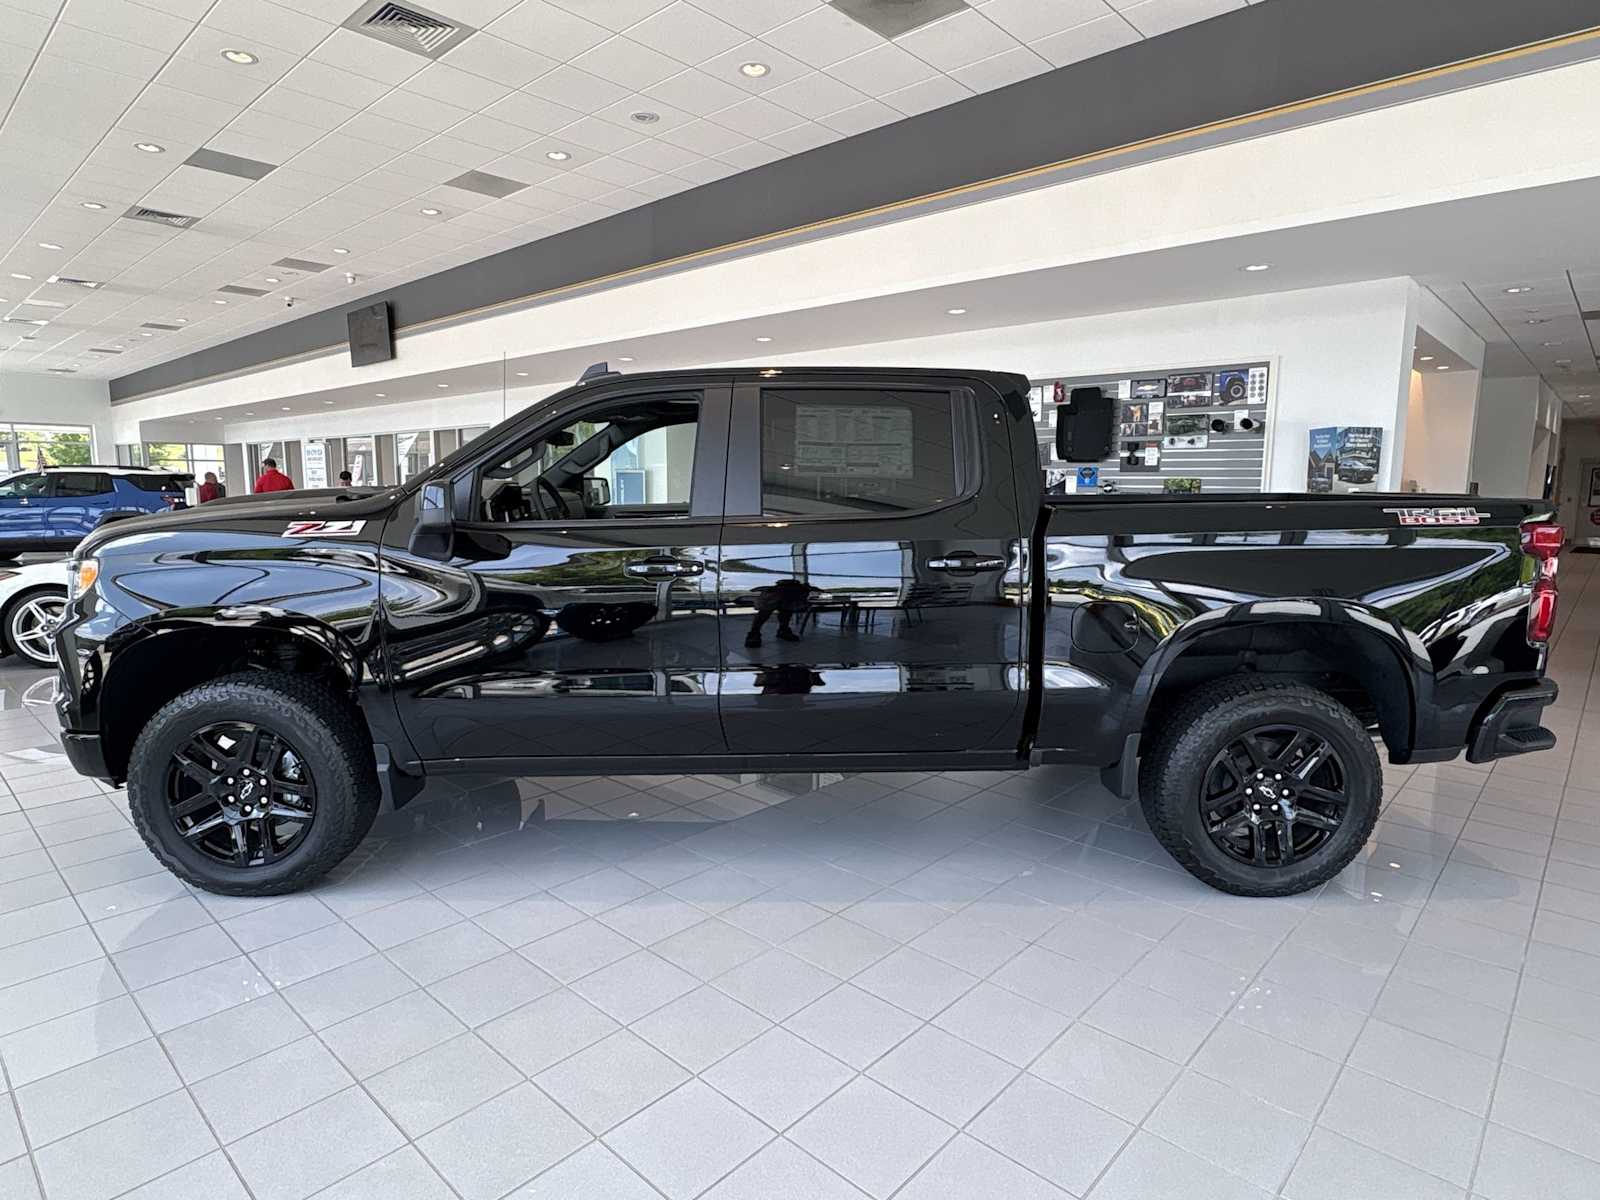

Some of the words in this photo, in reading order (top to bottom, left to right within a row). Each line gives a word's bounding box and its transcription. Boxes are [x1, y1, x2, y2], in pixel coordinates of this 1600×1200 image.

[1382, 507, 1491, 518] TRAIL
[1399, 516, 1480, 525] BOSS
[281, 519, 367, 538] Z71
